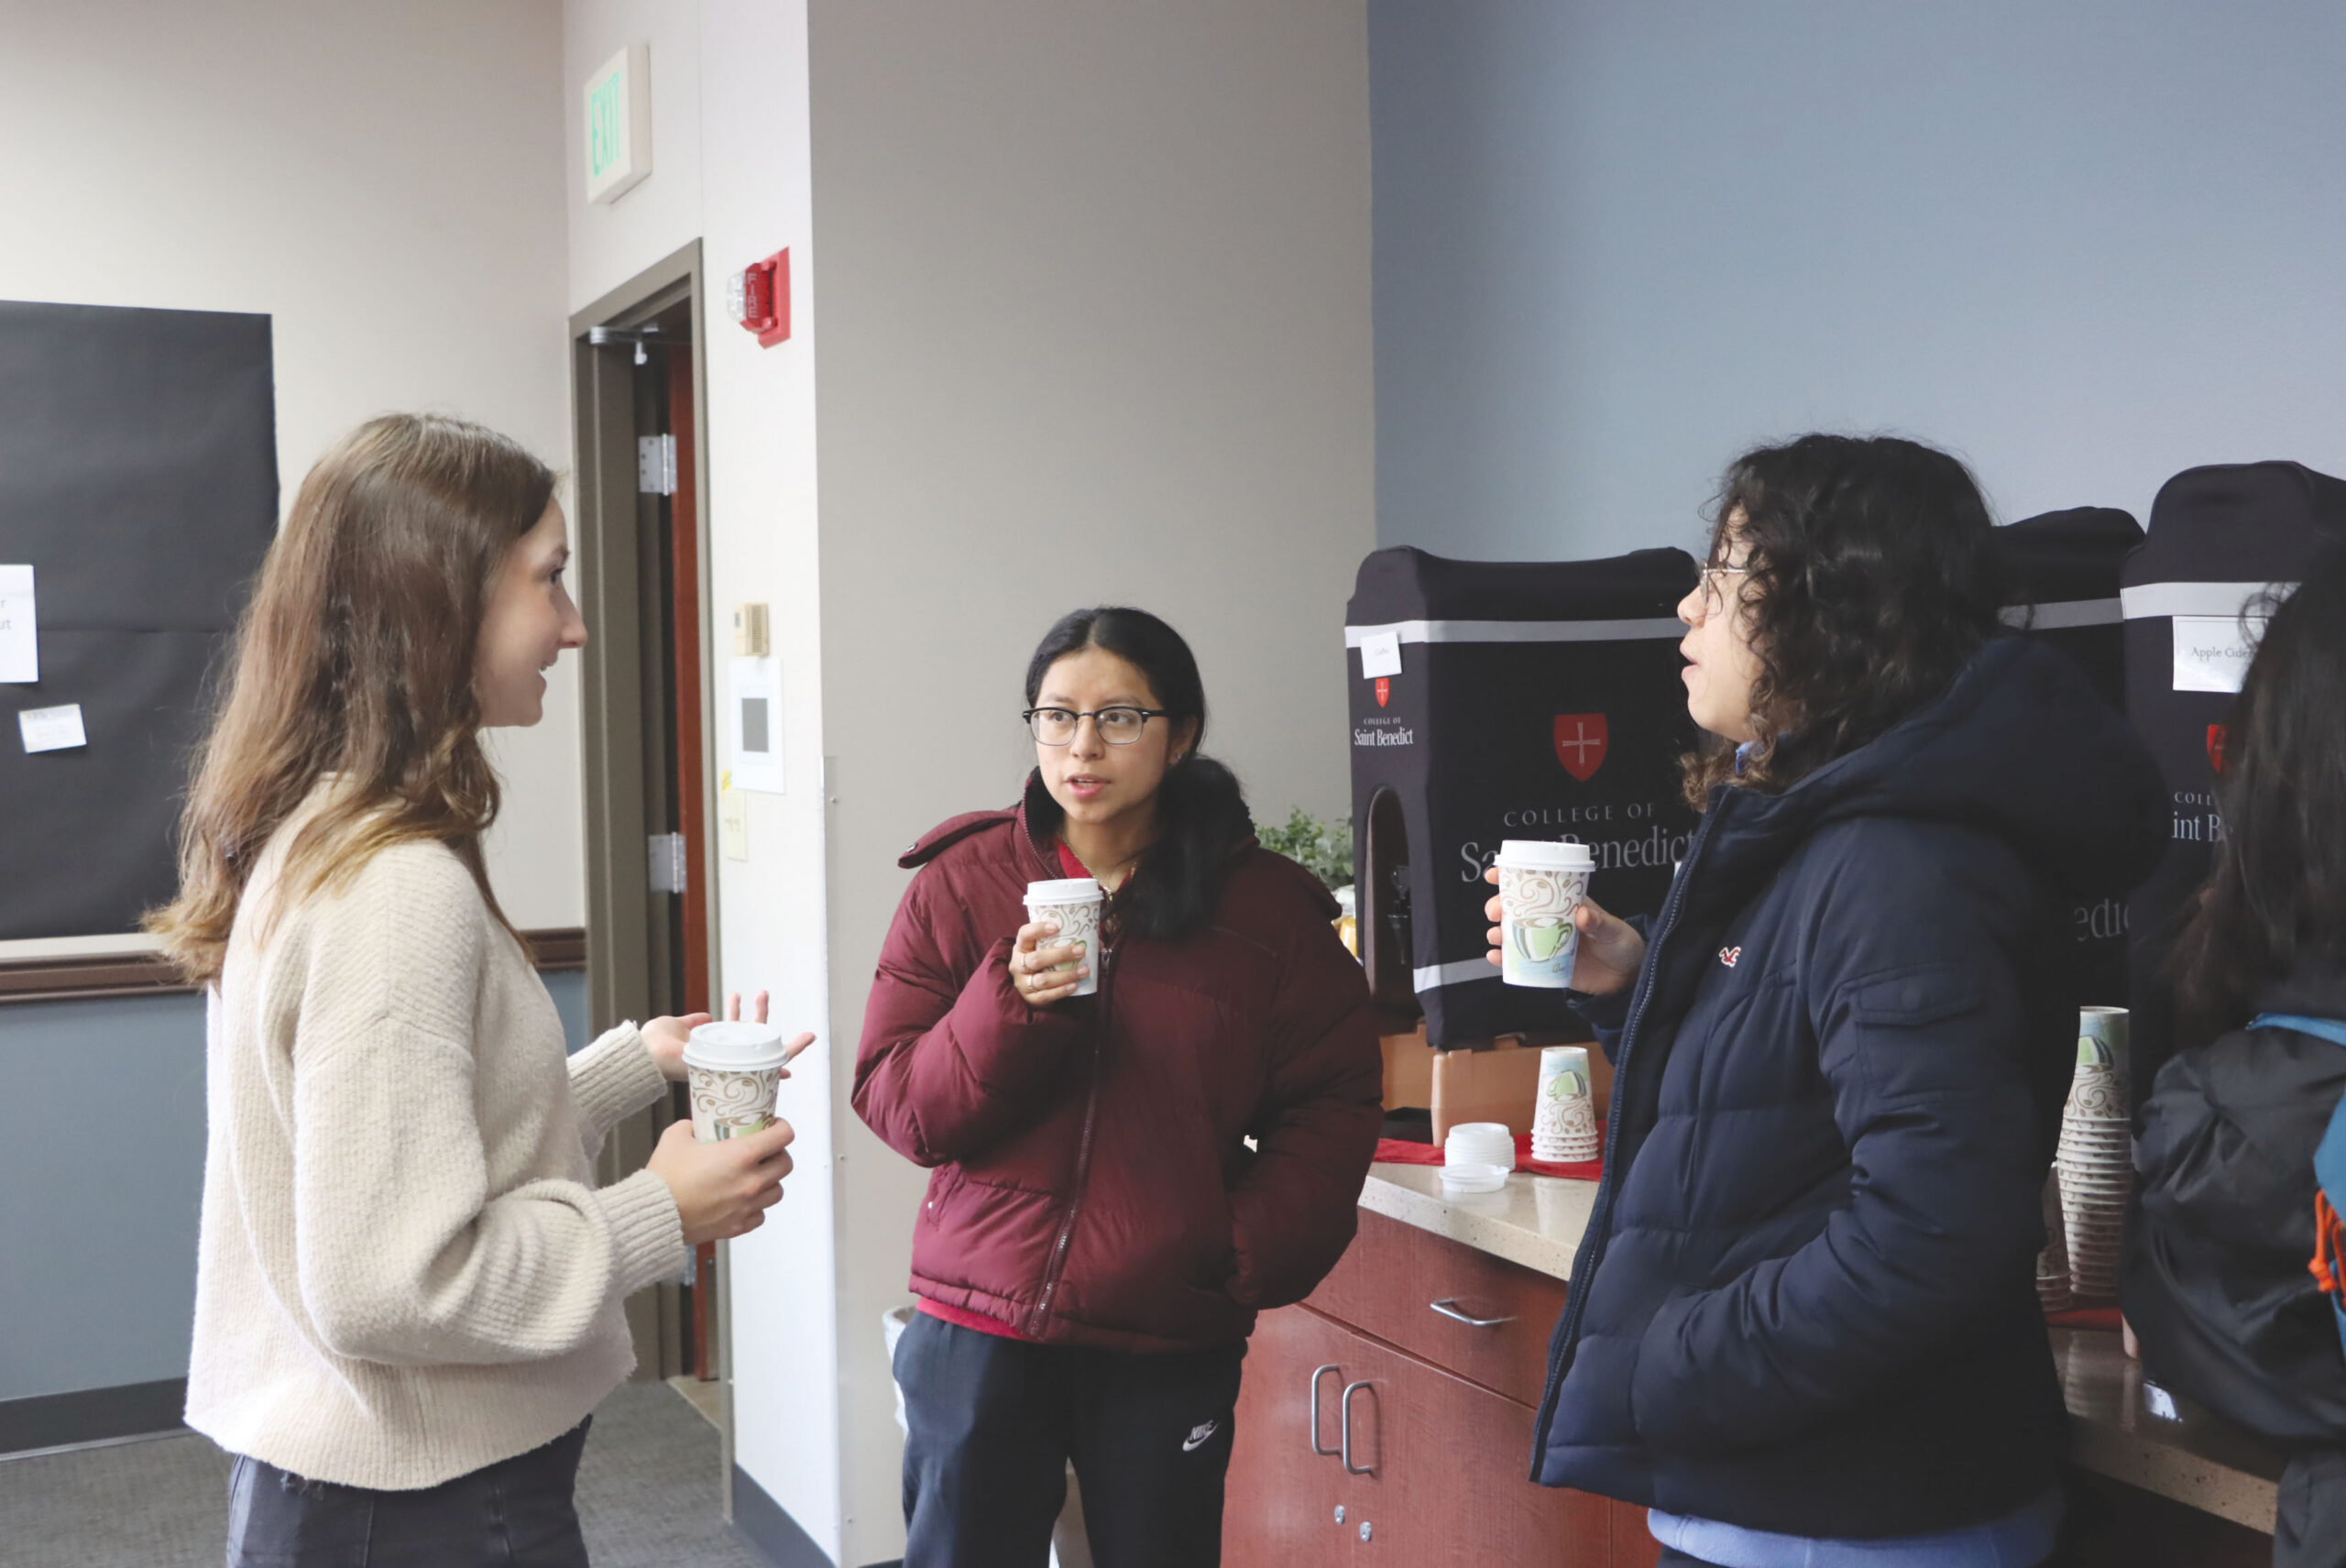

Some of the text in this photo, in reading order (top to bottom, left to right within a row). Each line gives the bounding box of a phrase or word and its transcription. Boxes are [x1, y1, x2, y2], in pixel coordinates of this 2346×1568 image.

[589, 70, 621, 177] EXIT
[747, 272, 759, 319] FIRE
[2191, 645, 2222, 662] Apple
[1354, 726, 1414, 747] Saint Benedict
[2174, 791, 2212, 806] COLL
[1503, 803, 1655, 828] COLLEGE OF
